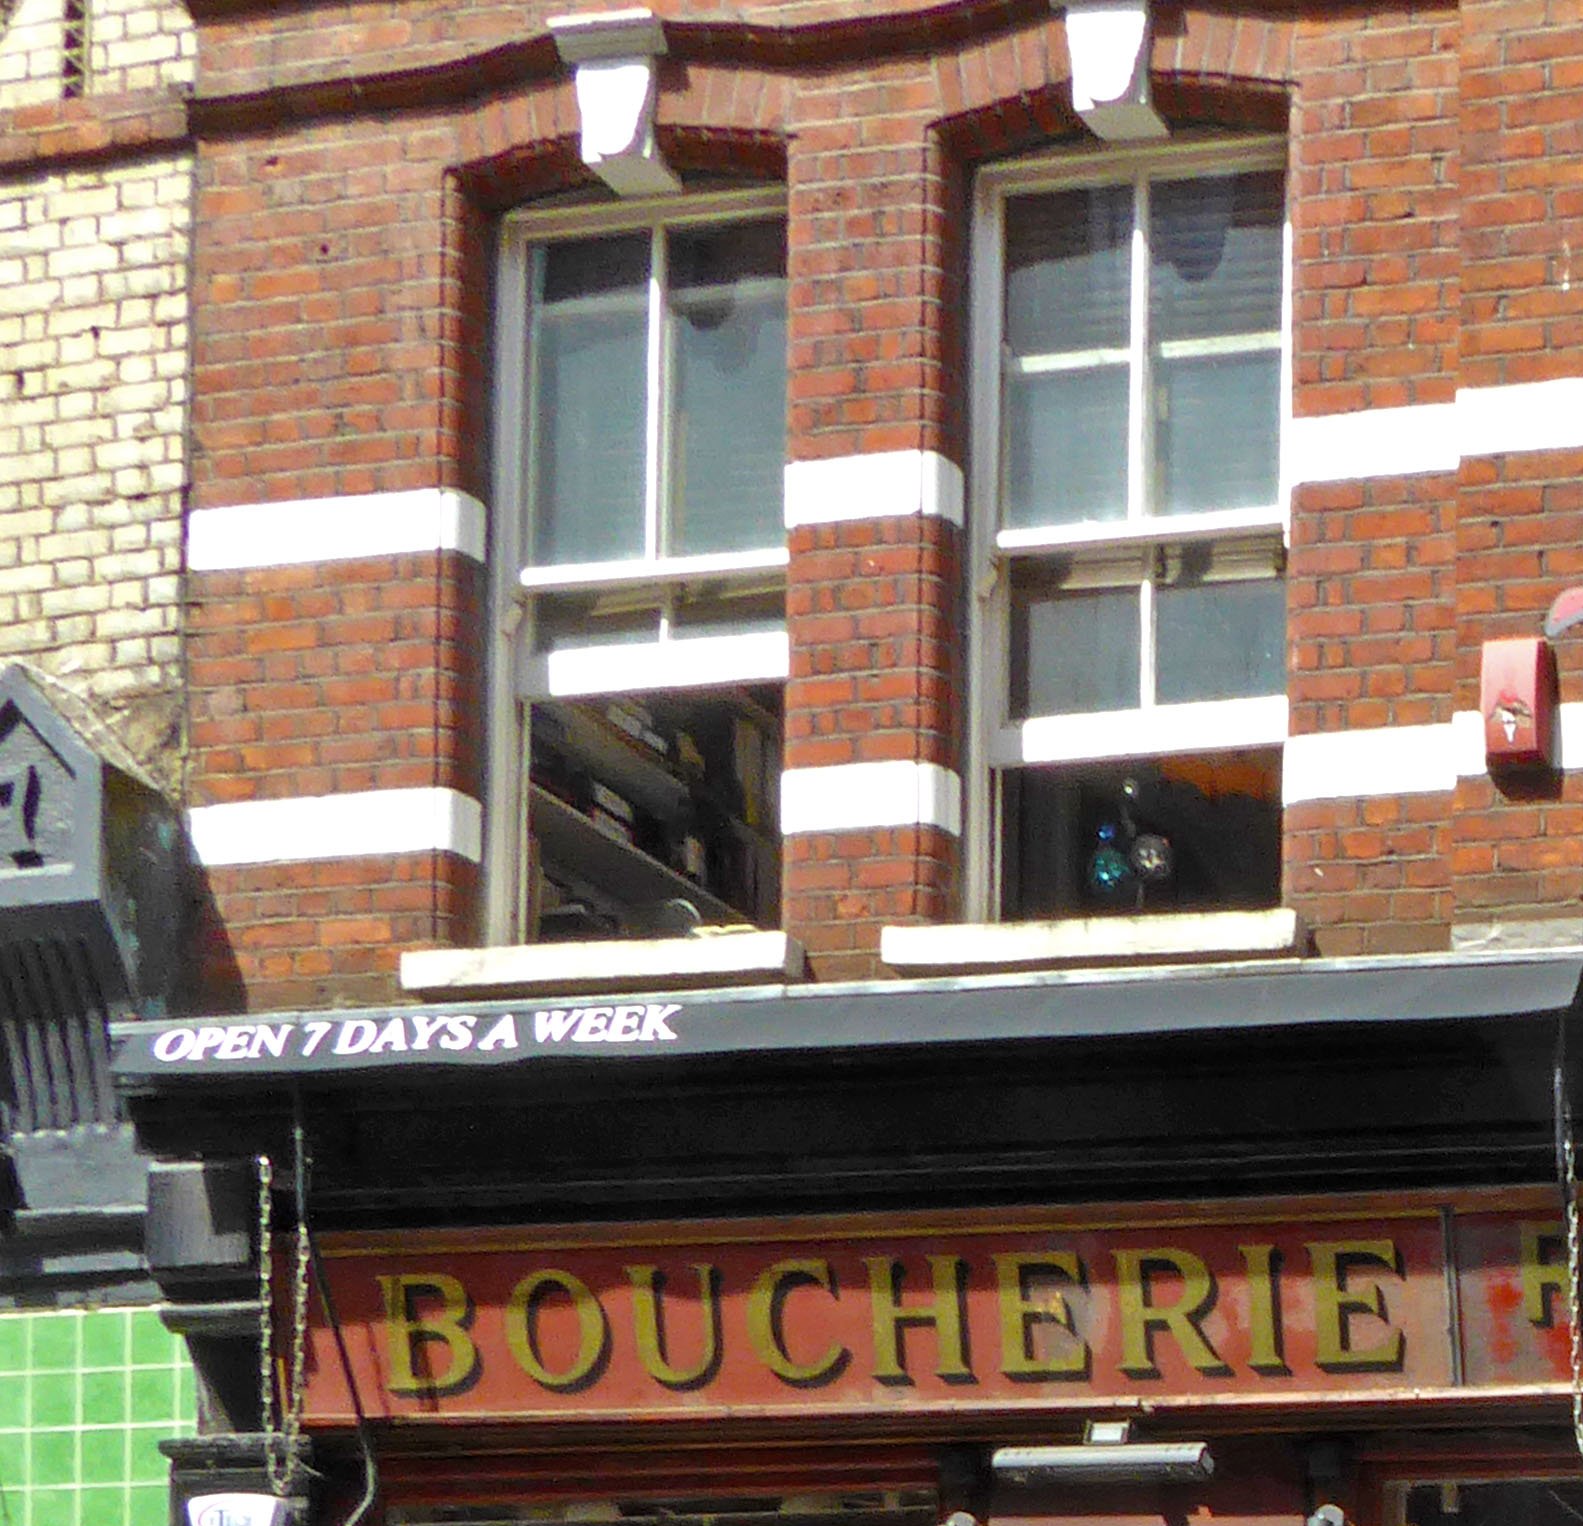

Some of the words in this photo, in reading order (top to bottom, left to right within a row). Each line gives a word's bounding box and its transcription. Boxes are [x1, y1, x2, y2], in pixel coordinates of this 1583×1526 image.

[153, 1023, 296, 1062] OPEN
[301, 1021, 331, 1056] 7
[334, 1014, 478, 1055] DAYS
[478, 1015, 519, 1050] A
[533, 1004, 682, 1043] WEEK
[374, 1237, 1408, 1398] BOUCHERIE
